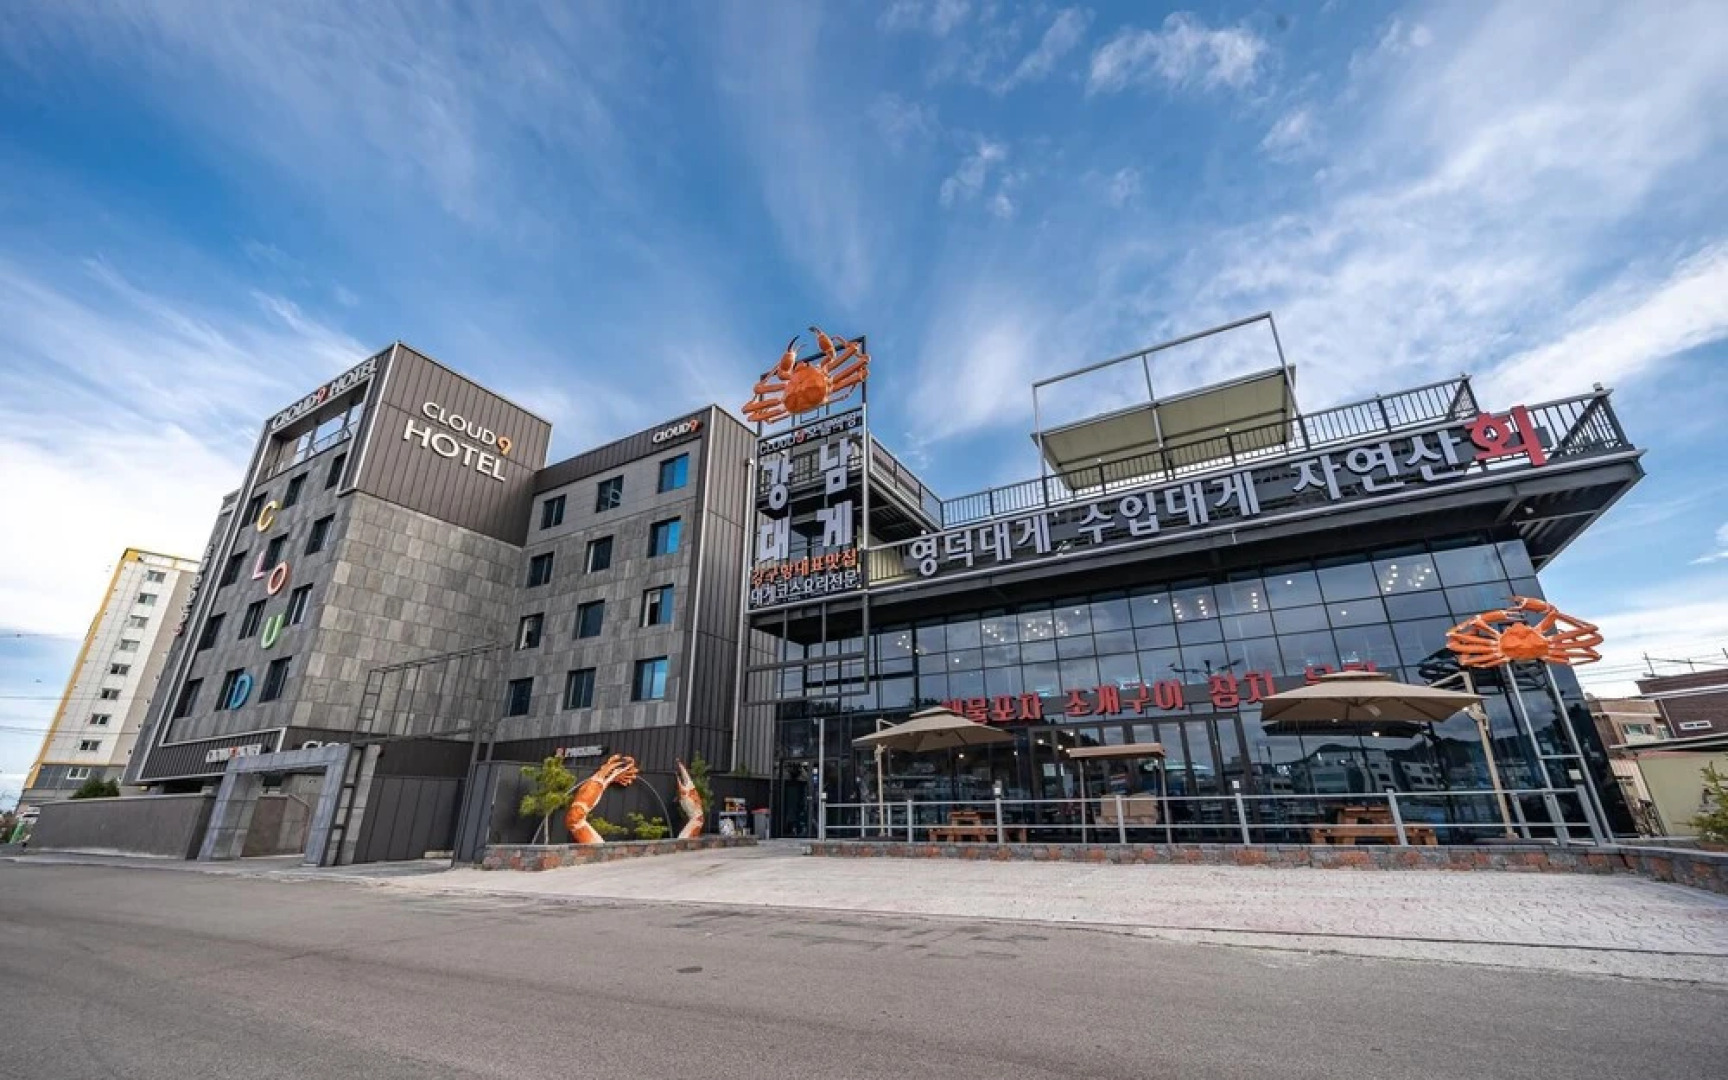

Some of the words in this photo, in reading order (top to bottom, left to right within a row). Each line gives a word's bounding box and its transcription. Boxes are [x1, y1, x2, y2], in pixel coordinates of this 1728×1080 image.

[404, 419, 506, 482] HOTEL
[422, 401, 513, 456] CLOUD9
[910, 513, 1052, 577] 영덕대게
[1077, 471, 1262, 544] 수입대게
[1064, 678, 1185, 718] 조개구이
[1208, 669, 1277, 708] 참치
